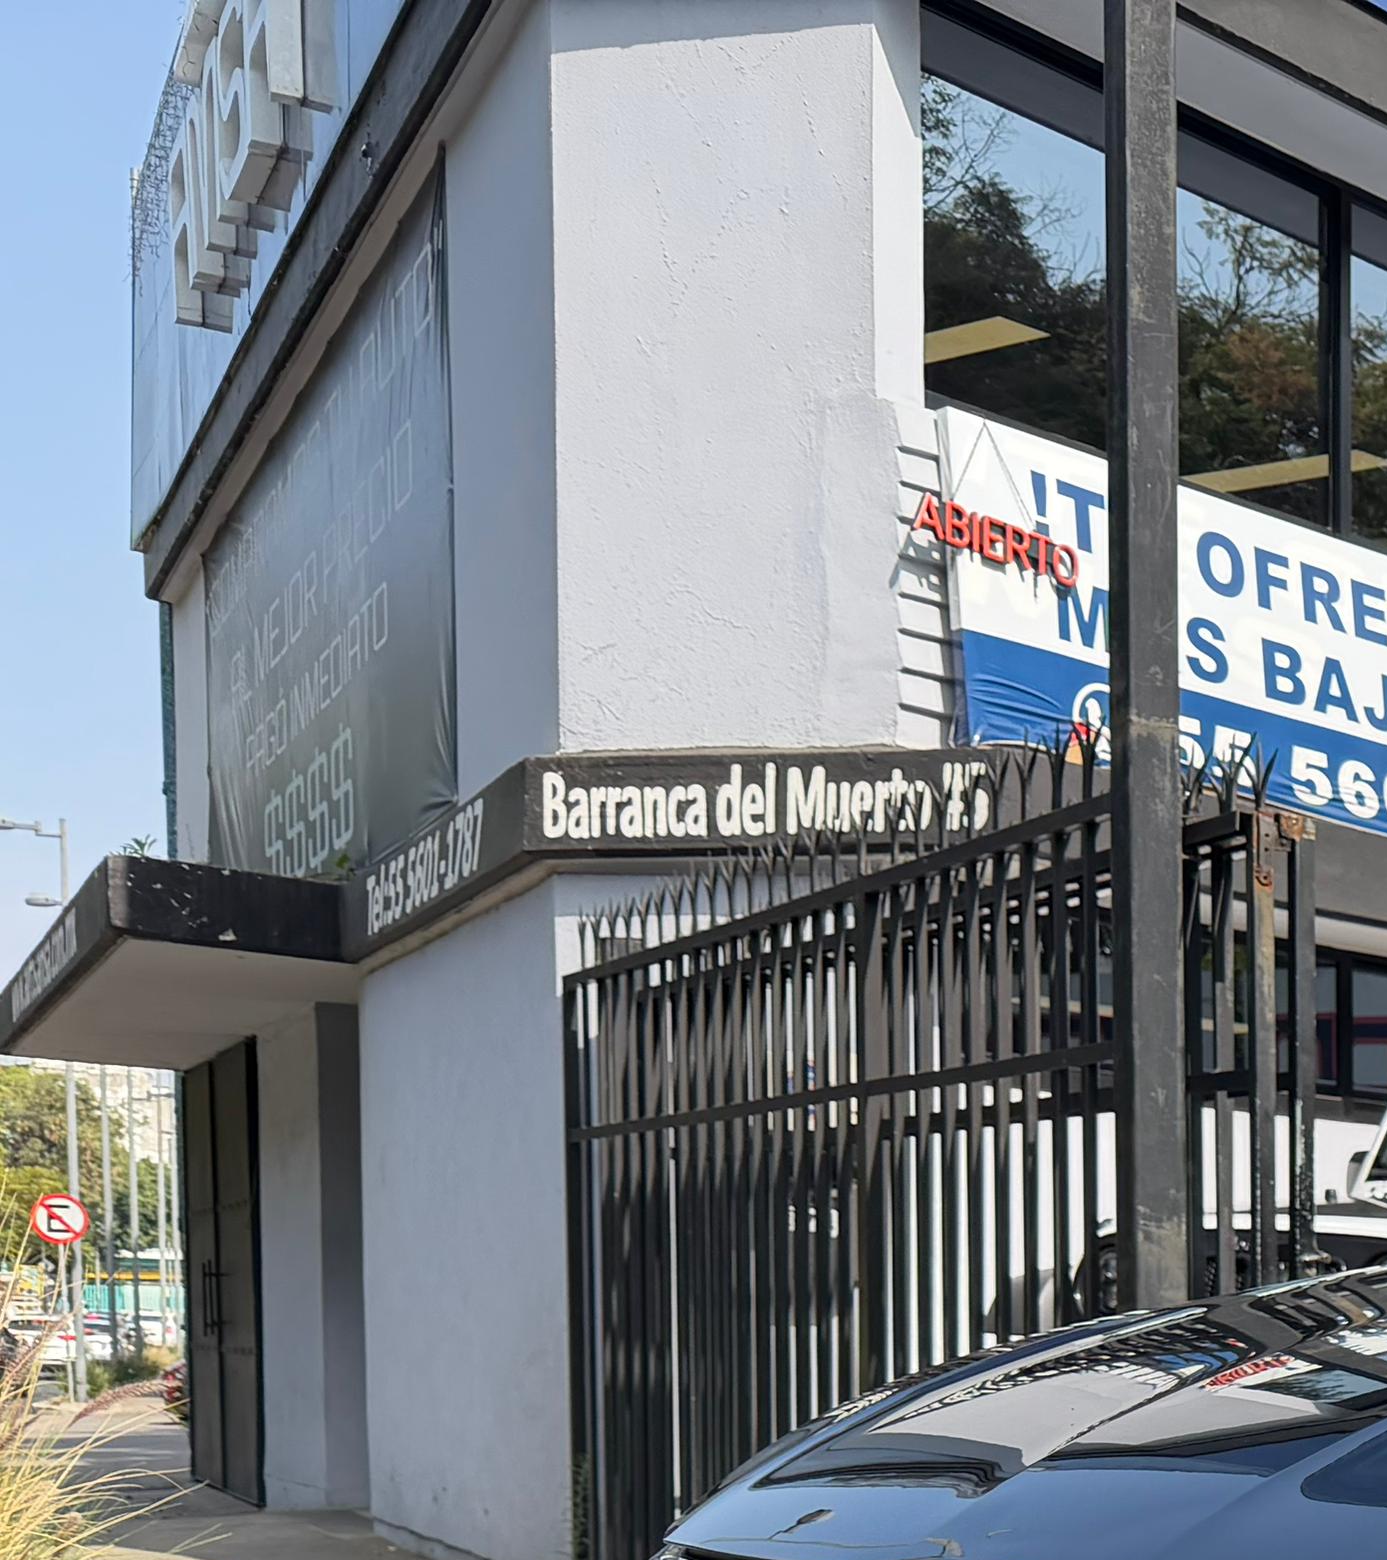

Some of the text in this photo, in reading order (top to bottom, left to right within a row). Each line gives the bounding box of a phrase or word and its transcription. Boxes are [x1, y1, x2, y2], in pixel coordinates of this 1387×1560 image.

[912, 491, 1080, 588] ABIERTO
[1056, 586, 1229, 683] MS
[542, 770, 708, 840] Barranca
[716, 762, 777, 837] del
[786, 765, 932, 836] Muerto
[405, 797, 484, 914] 5601-1787
